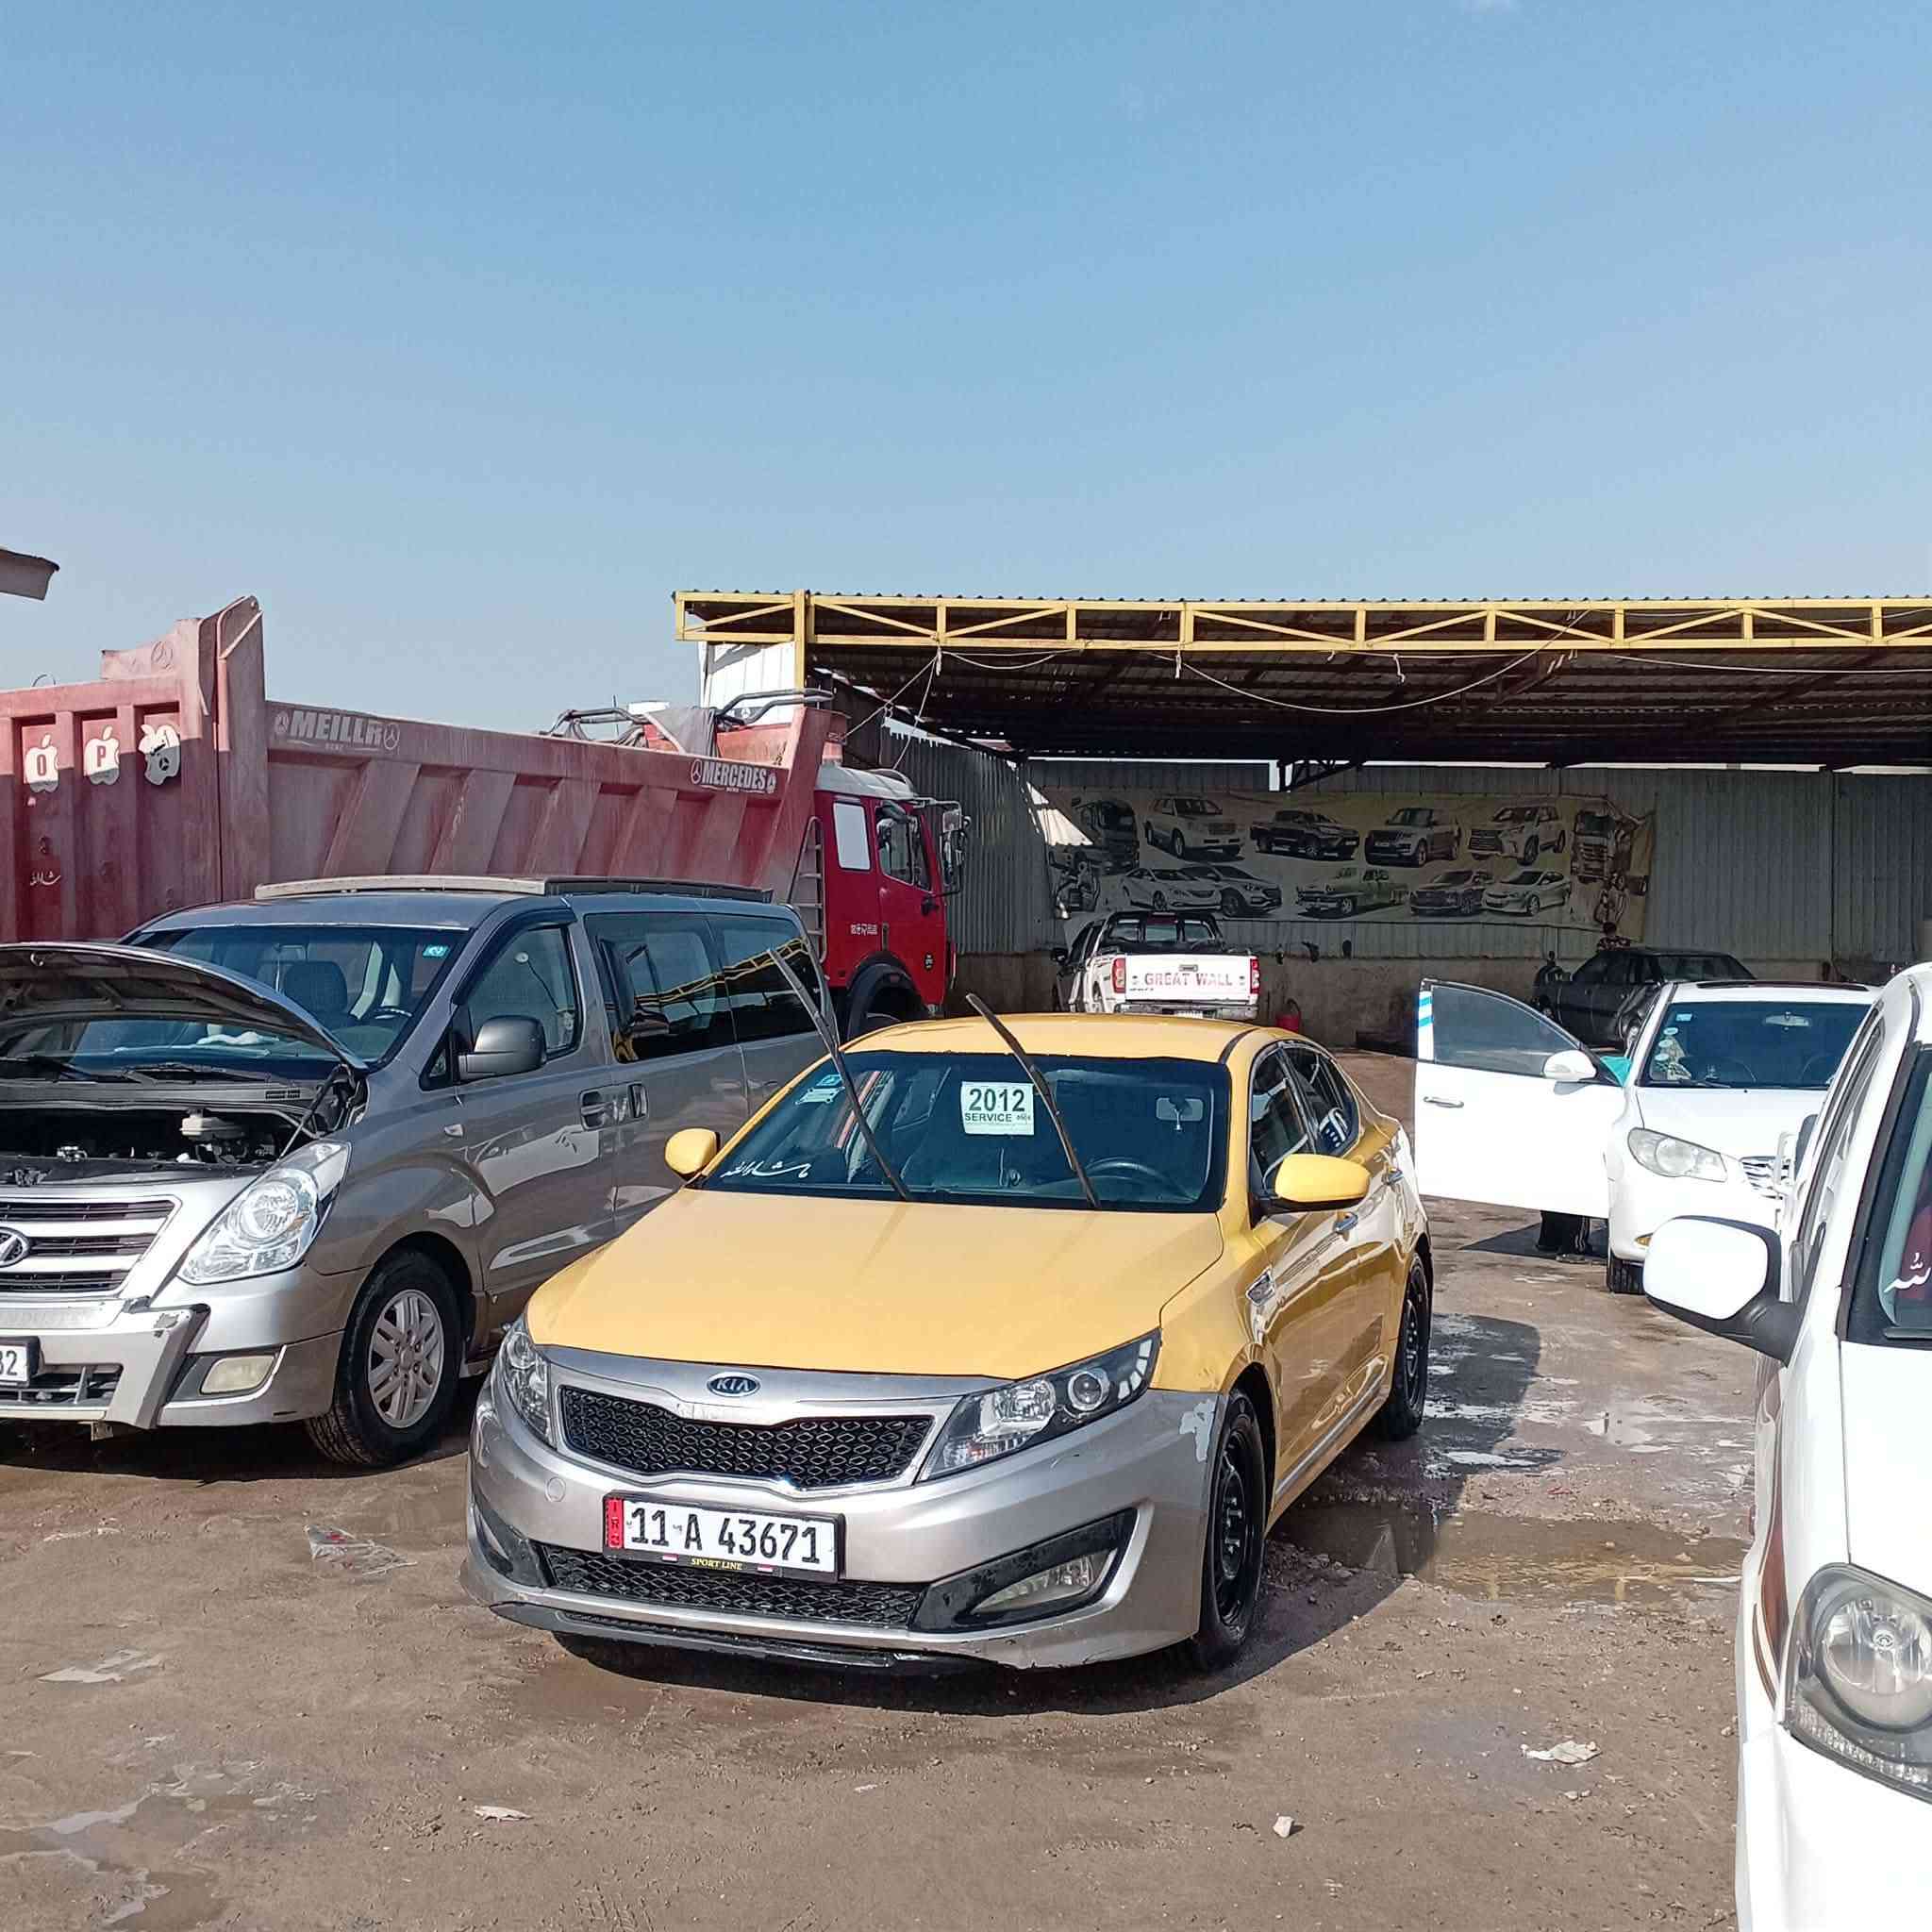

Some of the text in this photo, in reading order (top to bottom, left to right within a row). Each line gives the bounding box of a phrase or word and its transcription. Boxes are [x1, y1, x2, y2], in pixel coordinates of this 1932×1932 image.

[701, 760, 766, 790] MERCEDES
[1144, 973, 1233, 986] GREAT WALL
[969, 1088, 1025, 1112] 2012
[964, 1113, 1012, 1123] SERVICE
[717, 1378, 749, 1391] KIA
[631, 1507, 820, 1564] 11 A 43671
[691, 1557, 742, 1571] SPORT LINE
